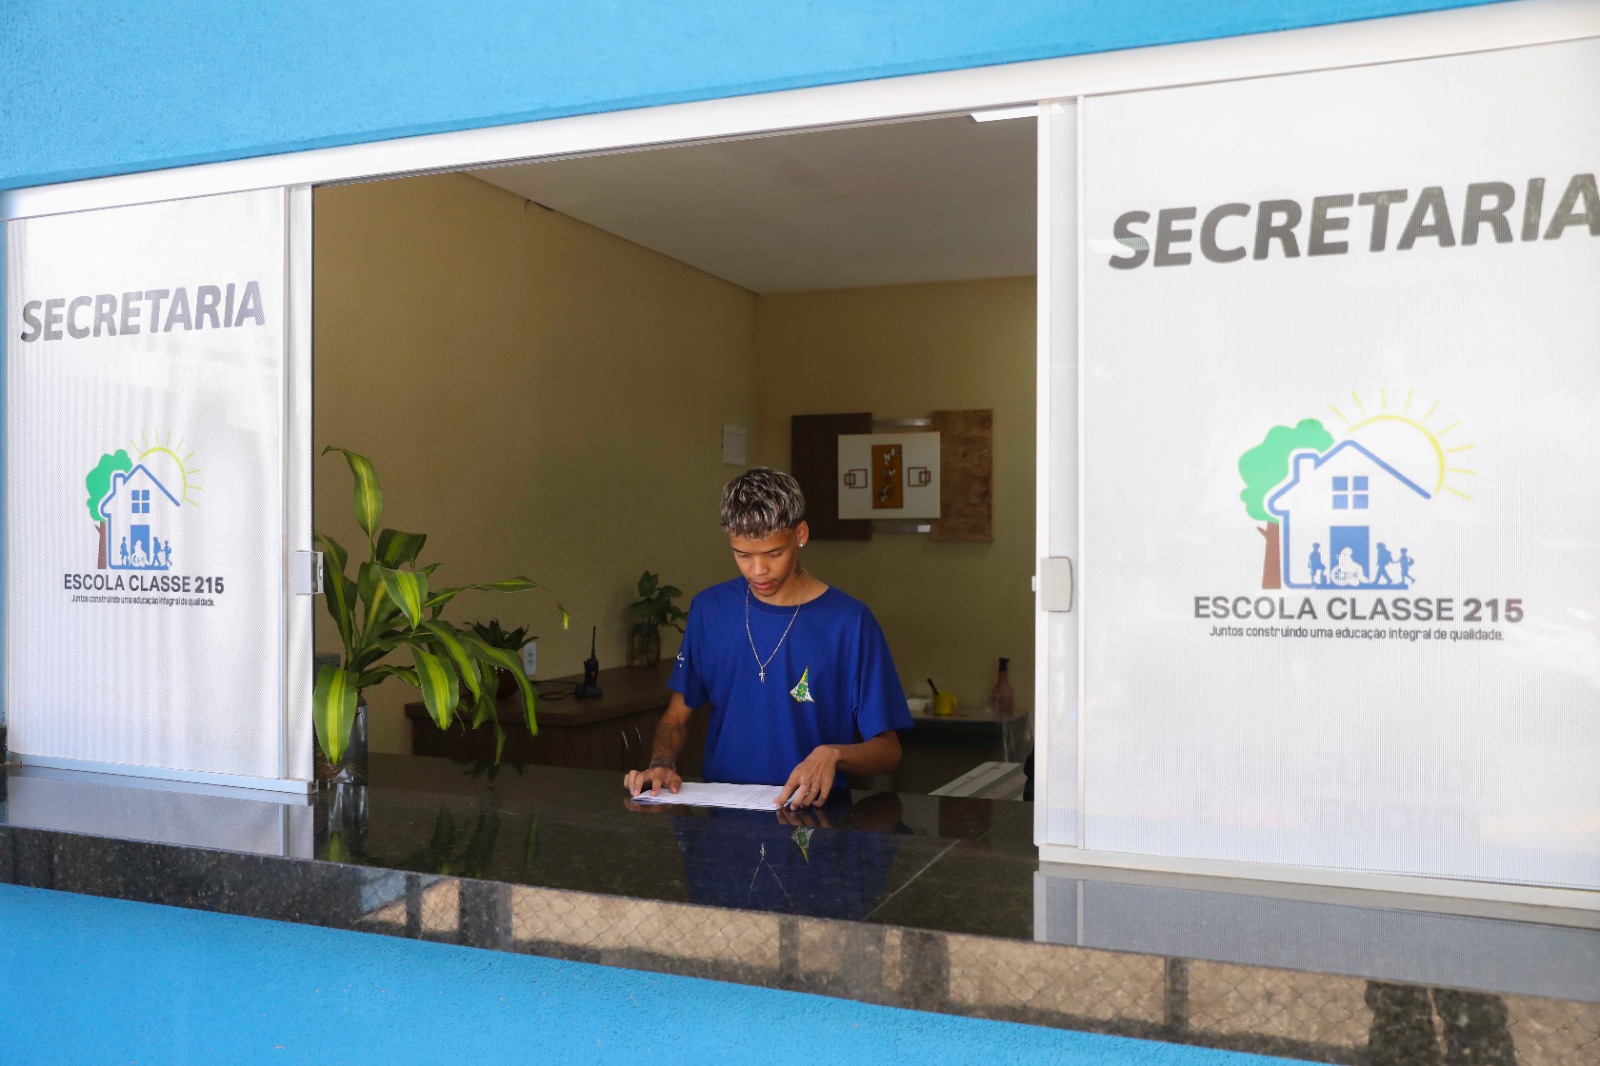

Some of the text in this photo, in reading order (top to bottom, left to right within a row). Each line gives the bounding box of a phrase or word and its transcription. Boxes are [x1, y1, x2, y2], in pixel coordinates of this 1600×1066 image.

[1108, 172, 1600, 270] SECRETARIA
[20, 280, 265, 343] SECRETARIA
[63, 573, 225, 594] ESCOLA CLASSE 215
[1194, 595, 1524, 623] ESCOLA CLASSE 215
[1209, 625, 1504, 643] Juntos construindo uma educação integral de qualidade.
